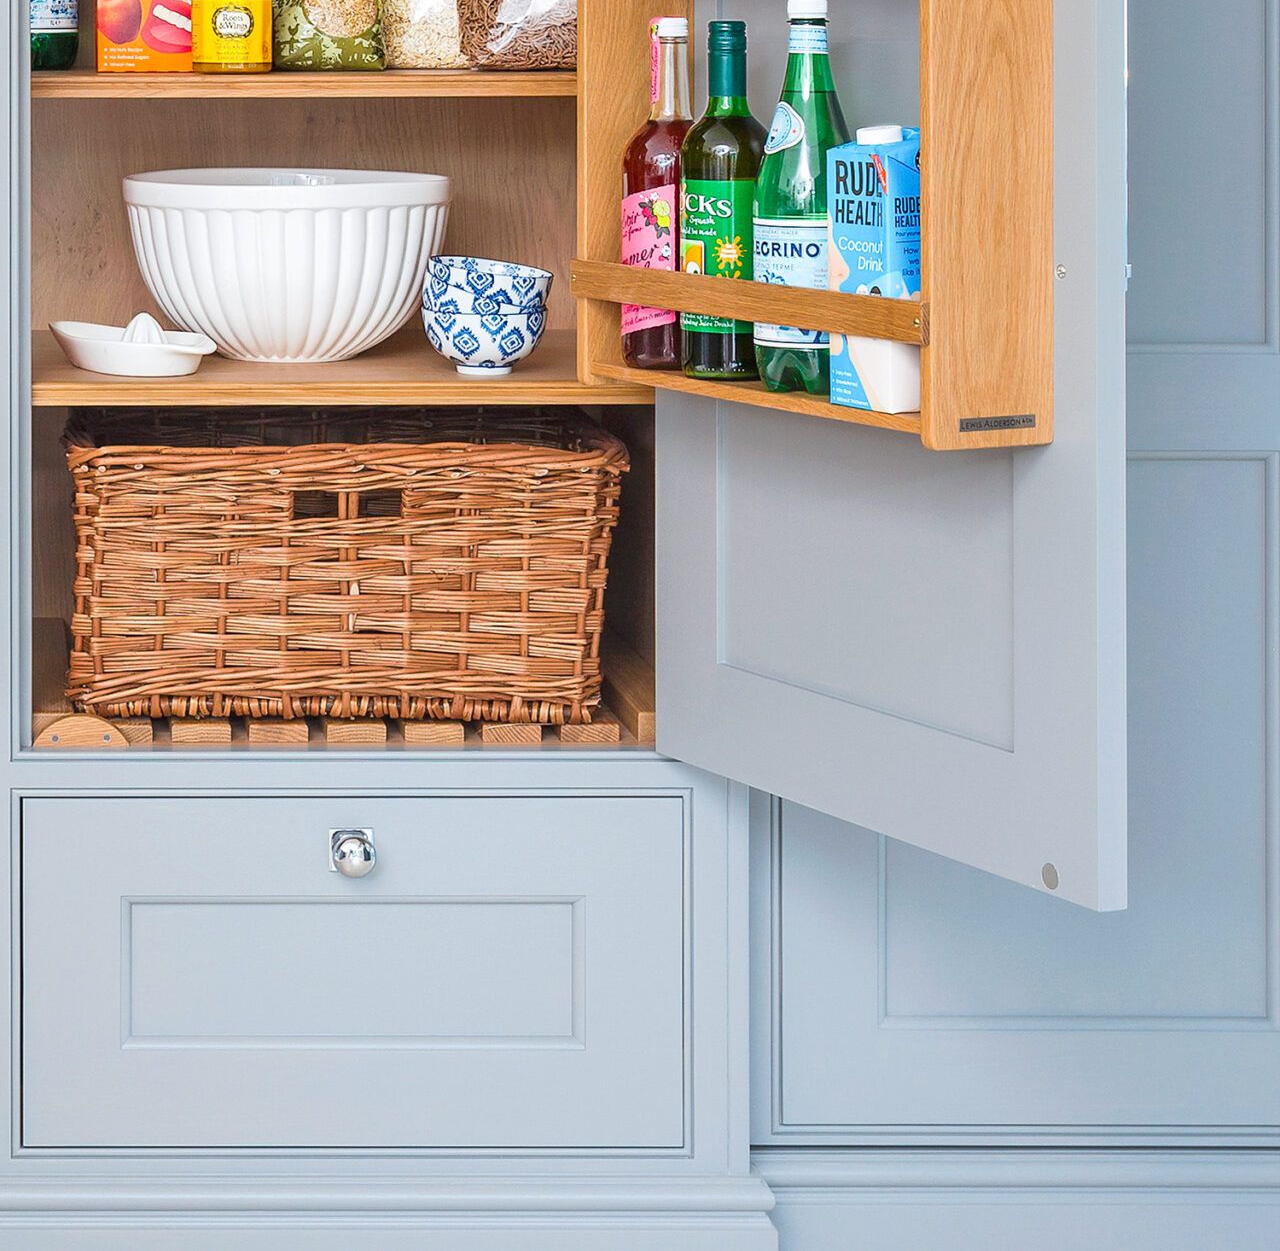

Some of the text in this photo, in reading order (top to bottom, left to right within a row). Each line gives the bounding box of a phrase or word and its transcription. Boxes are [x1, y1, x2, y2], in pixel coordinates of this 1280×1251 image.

[222, 13, 244, 22] Roots
[834, 199, 883, 228] HEALTH
[688, 214, 716, 226] Squash
[698, 229, 717, 237] made
[837, 236, 884, 255] Coconut
[857, 255, 884, 273] Drink
[960, 419, 1021, 430] LEWIS ALDERSON
